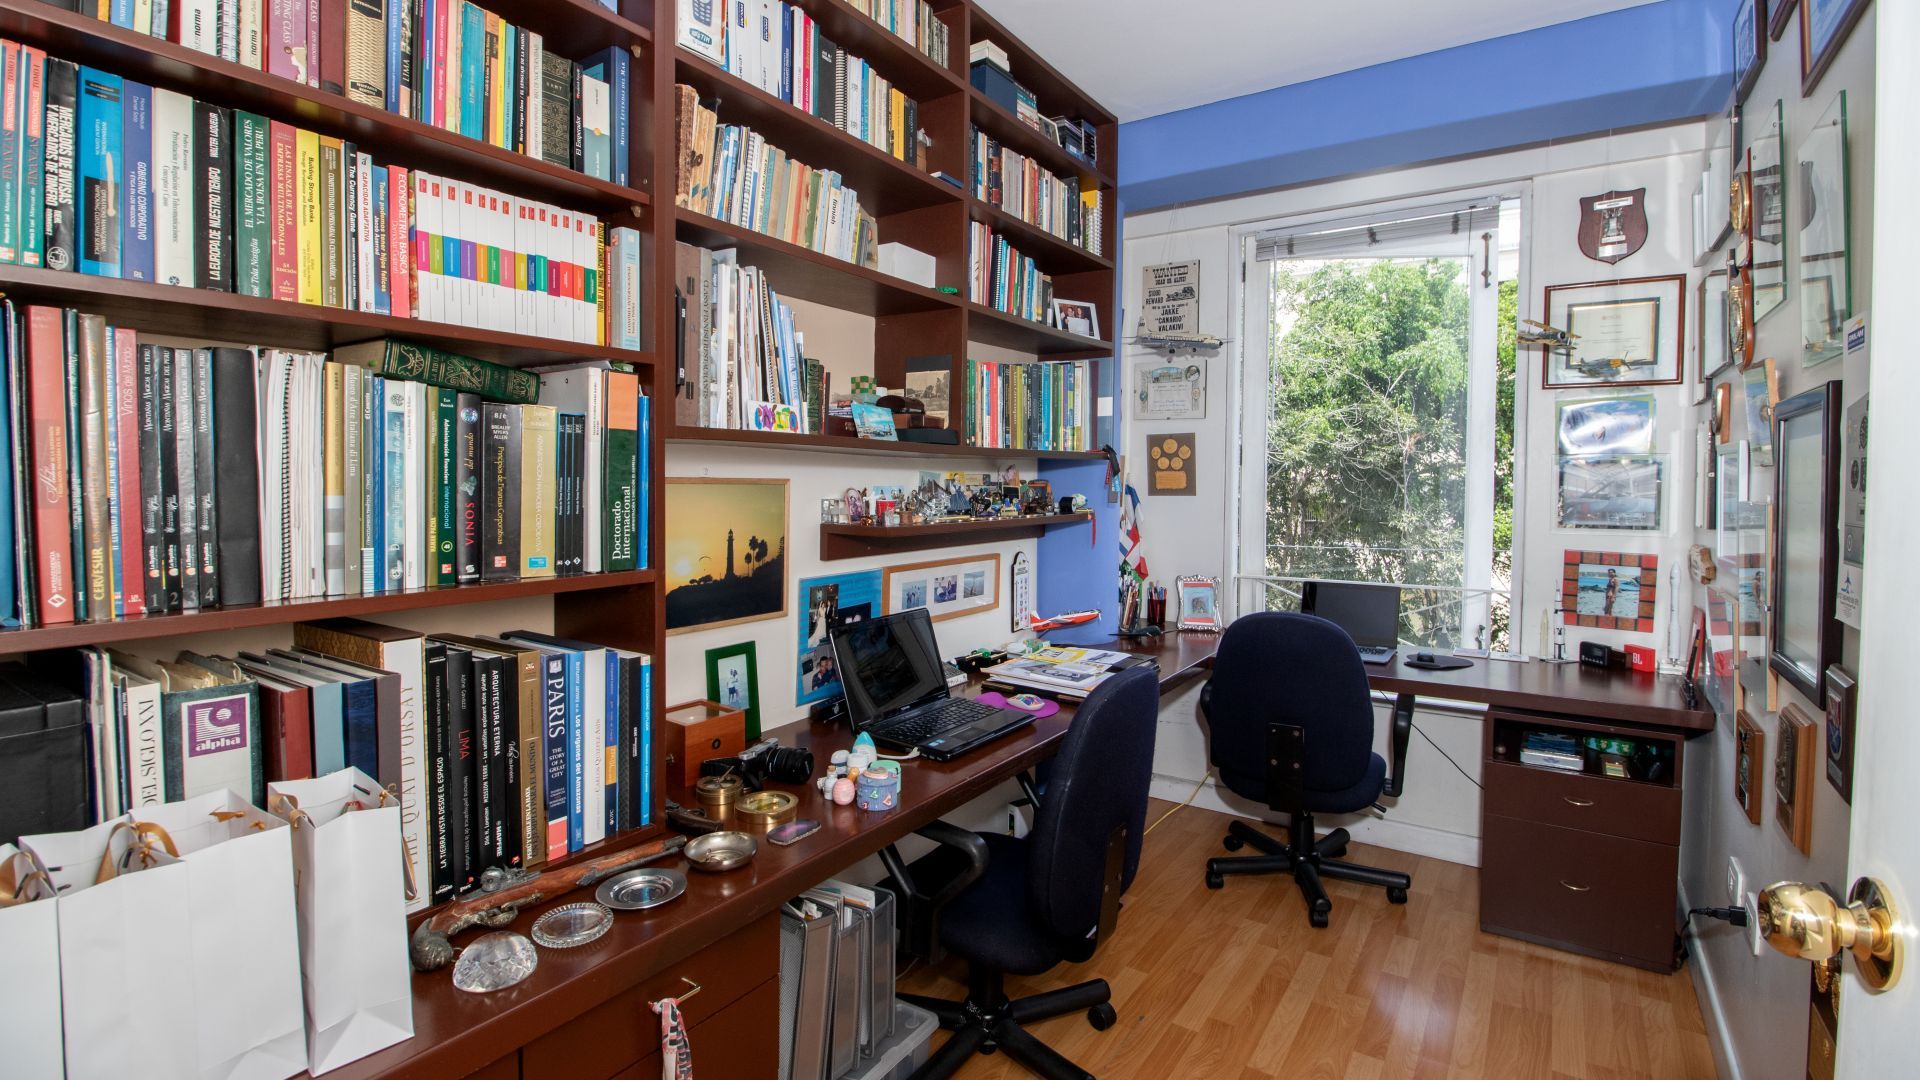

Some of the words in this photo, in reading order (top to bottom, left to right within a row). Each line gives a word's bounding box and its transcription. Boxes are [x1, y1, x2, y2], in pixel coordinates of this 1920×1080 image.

[46, 111, 58, 160] MERCADOS
[59, 106, 72, 156] MERCADOS
[243, 119, 253, 156] VALORES
[3, 131, 14, 180] FINANZAS
[27, 138, 37, 186] FINANZAS
[59, 157, 71, 169] DE
[244, 158, 253, 169] DE
[256, 149, 265, 160] EL
[46, 161, 58, 173] DE
[256, 162, 265, 176] EN
[307, 157, 315, 180] Building
[349, 165, 357, 174] The
[59, 169, 72, 204] DIVISAS
[137, 162, 147, 195] GOBIERNO
[208, 167, 220, 192] TIEMPO
[45, 174, 58, 206] DINERO
[244, 172, 253, 215] MERCADO
[256, 178, 264, 204] BOLSA
[307, 182, 315, 203] Strong
[349, 175, 357, 211] Currency
[209, 194, 220, 227] NUESTRO
[256, 205, 264, 216] LA
[285, 199, 292, 210] DE
[830, 198, 839, 225] finnish
[137, 196, 147, 240] CORPORATIVO
[245, 217, 253, 228] EL
[277, 181, 285, 256] MULTINACIONALES
[349, 212, 357, 232] Game
[209, 228, 220, 237] DE
[209, 238, 220, 269] EUROPA
[210, 271, 221, 280] LA
[1153, 265, 1188, 278] WANTED
[1145, 297, 1164, 305] REWARD
[121, 347, 132, 373] Mundo
[122, 376, 133, 386] del
[349, 372, 359, 395] Museo
[121, 388, 133, 416] Vinos
[349, 397, 359, 419] d'Arte
[349, 422, 359, 449] Italiana
[464, 432, 474, 457] mundo
[349, 450, 359, 458] di
[464, 459, 474, 469] del
[494, 446, 504, 474] Principios
[349, 459, 359, 477] Lima
[497, 483, 505, 507] Finanzas
[465, 502, 475, 545] VINOS
[494, 508, 504, 545] Corporativas
[612, 501, 622, 560] Doctorado
[622, 486, 632, 559] Internacional
[91, 547, 104, 601] CERVESUR
[150, 594, 159, 607] 1
[169, 592, 179, 606] 2
[188, 592, 198, 606] 3
[204, 587, 215, 601] 4
[1632, 653, 1643, 664] BL
[491, 670, 500, 725] ARQUITECTURA
[548, 676, 565, 739] PARIS
[195, 736, 241, 751] alpha
[459, 729, 470, 760] LIMA
[493, 727, 501, 756] ETERNA
[139, 730, 156, 776] SIGLO
[549, 753, 565, 761] STORY
[437, 757, 445, 783] ESPACIO
[549, 764, 565, 773] GREAT
[438, 784, 445, 793] EL
[530, 776, 537, 785] EL
[438, 794, 446, 814] DESDE
[525, 802, 531, 810] LA
[439, 815, 447, 835] VISTA
[525, 810, 531, 821] EN
[439, 836, 447, 858] TIERRA
[439, 859, 447, 869] LA
